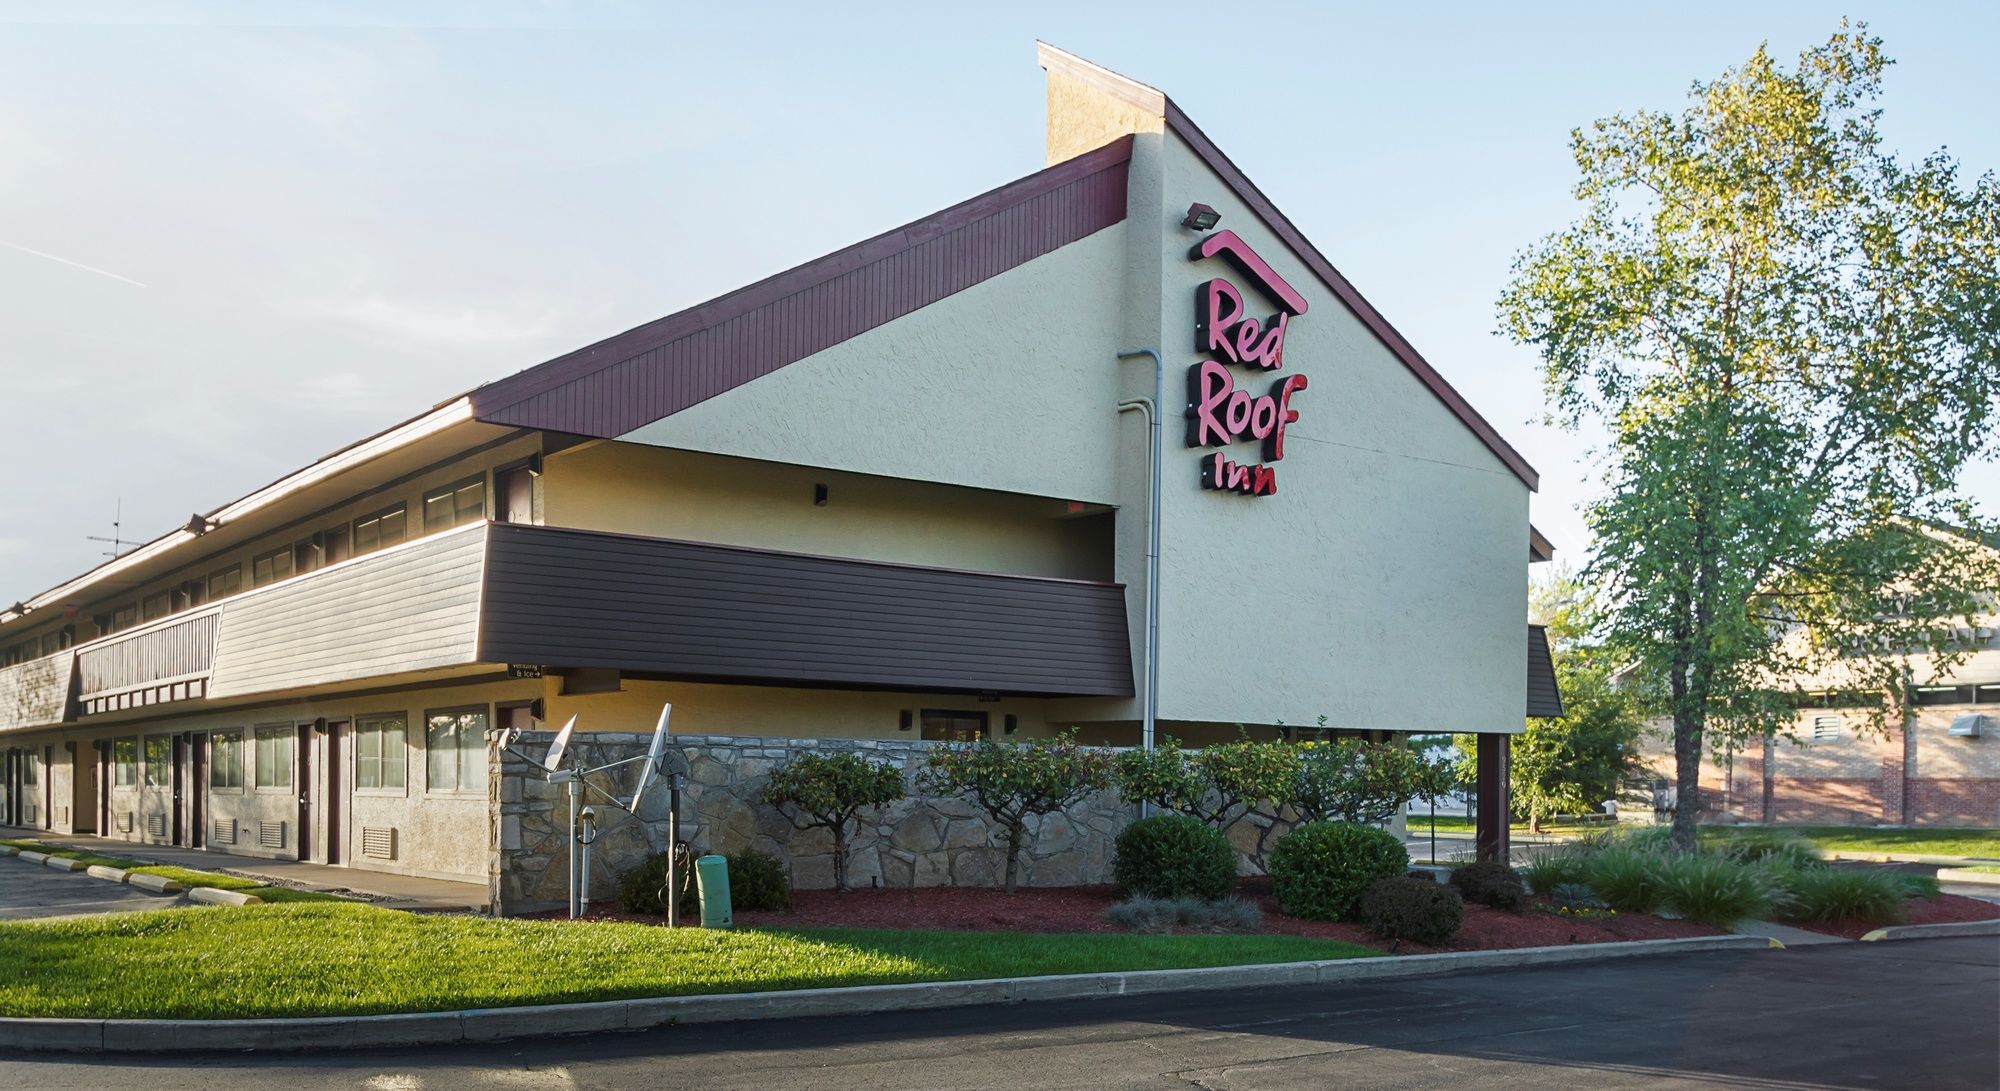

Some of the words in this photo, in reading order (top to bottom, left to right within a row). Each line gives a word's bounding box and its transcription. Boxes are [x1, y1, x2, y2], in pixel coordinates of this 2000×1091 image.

[1207, 278, 1288, 370] Red
[1198, 360, 1308, 461] Roof
[1214, 451, 1278, 496] Inn
